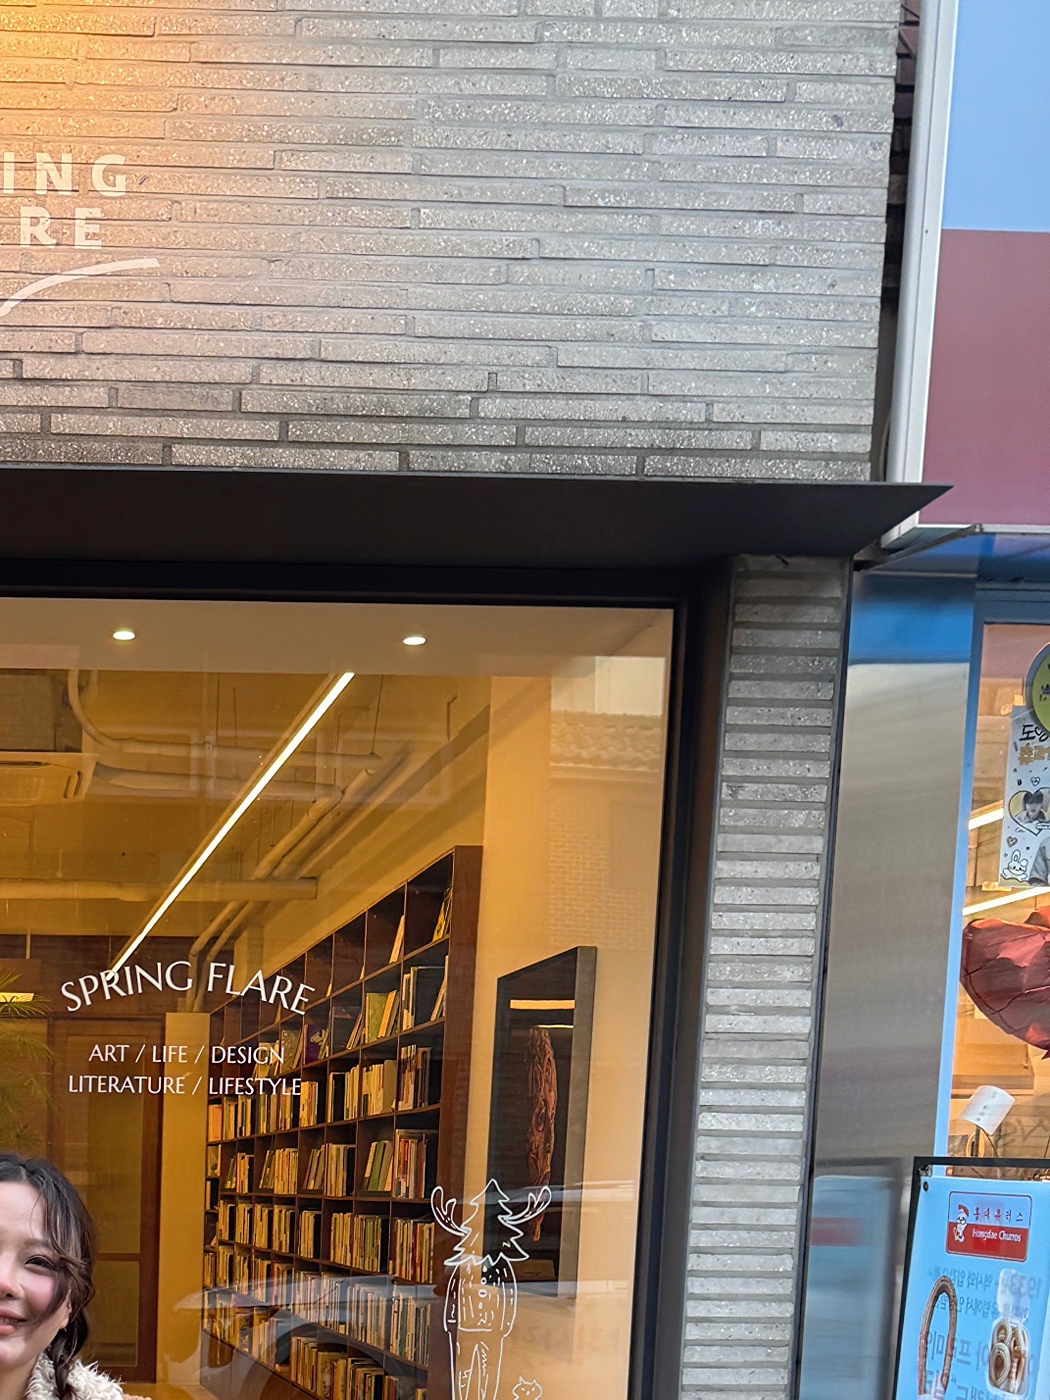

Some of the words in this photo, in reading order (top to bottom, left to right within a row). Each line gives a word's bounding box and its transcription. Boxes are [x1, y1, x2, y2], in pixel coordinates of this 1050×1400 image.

[61, 960, 193, 1012] SPRING
[207, 962, 315, 1015] FLARE
[88, 1044, 130, 1062] ART
[135, 1044, 146, 1063] /
[152, 1045, 188, 1063] LIFE
[195, 1045, 205, 1064] /
[211, 1046, 285, 1064] DESIGN
[68, 1075, 185, 1094] LITERATURE
[192, 1076, 203, 1095] /
[209, 1077, 302, 1095] LIFESTYLE
